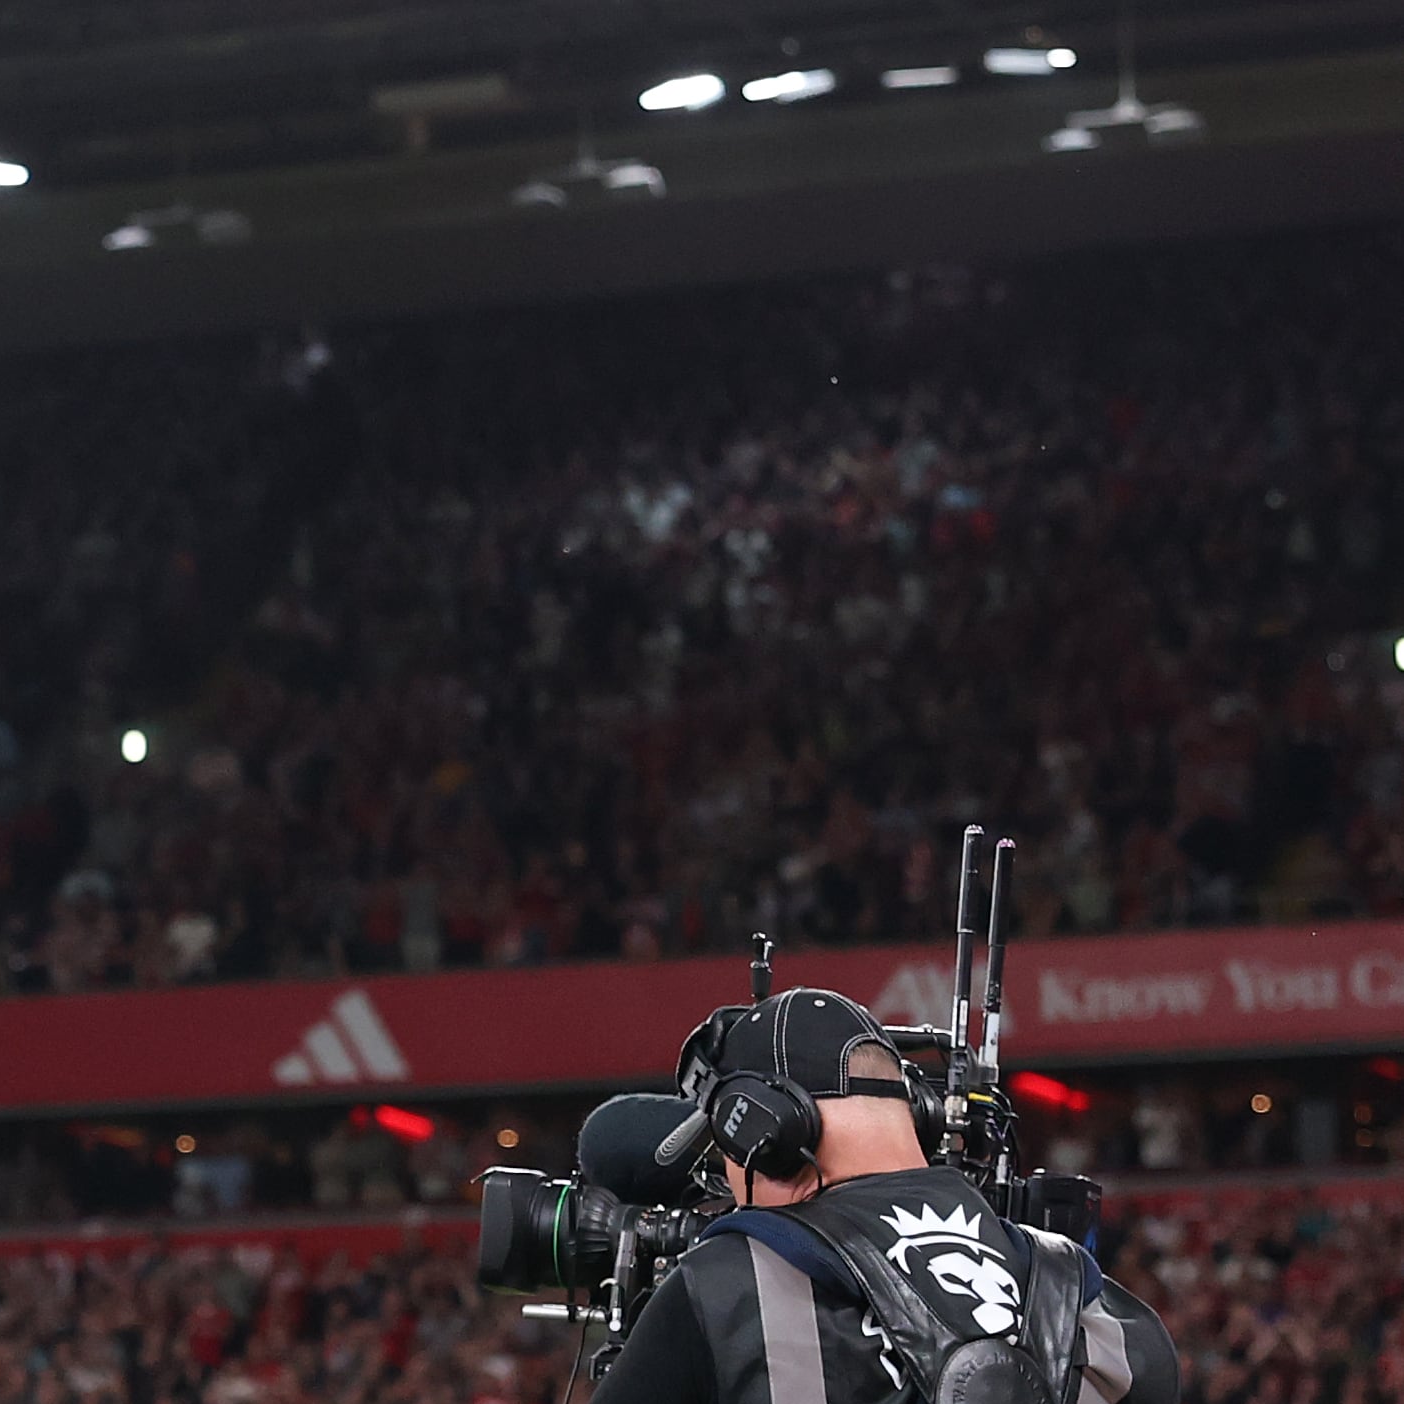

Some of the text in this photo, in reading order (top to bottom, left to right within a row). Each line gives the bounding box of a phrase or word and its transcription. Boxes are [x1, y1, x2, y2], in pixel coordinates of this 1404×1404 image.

[1037, 965, 1211, 1024] Know
[1223, 956, 1341, 1013] You
[723, 1096, 749, 1139] RTS
